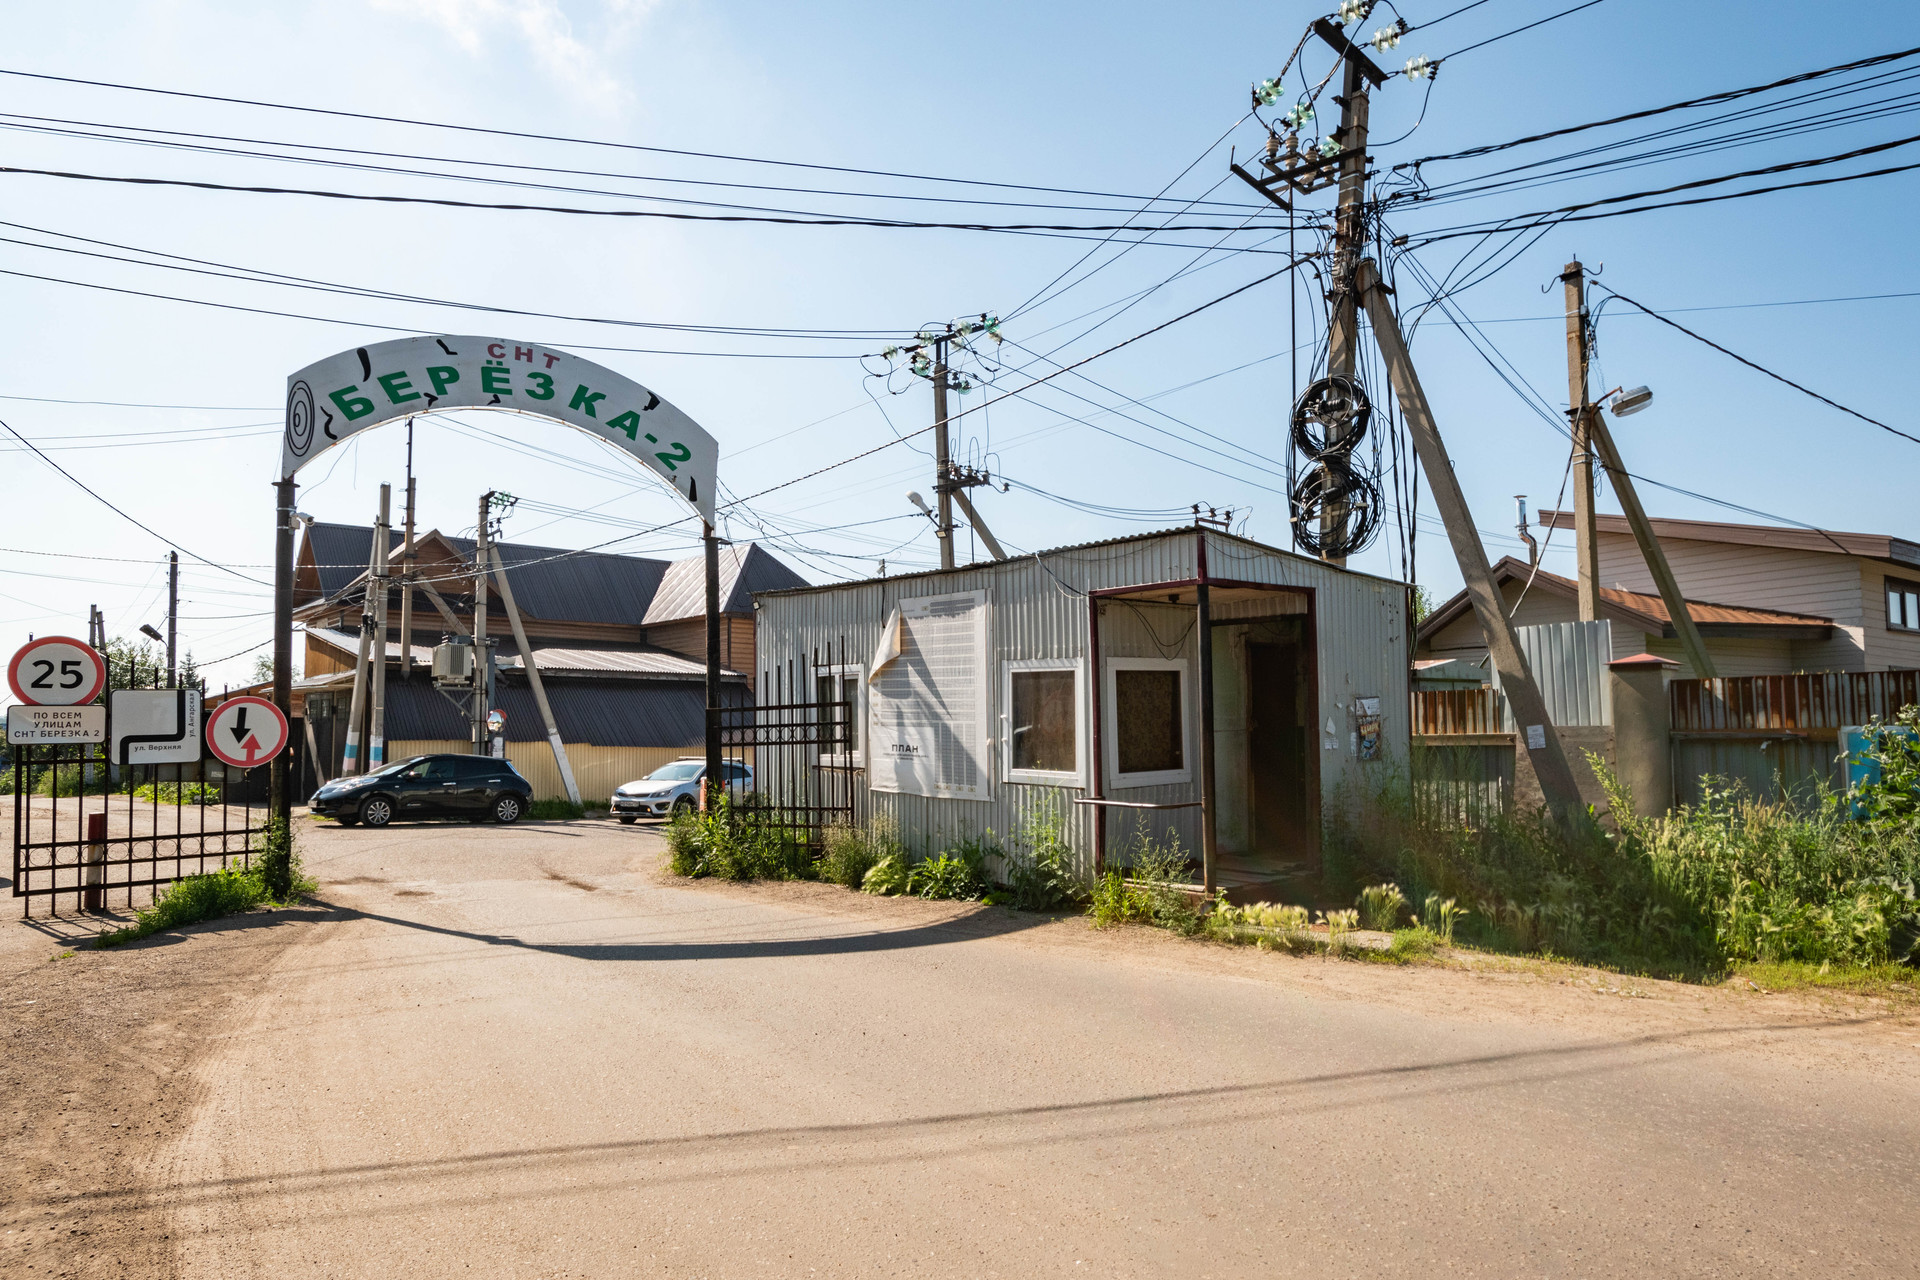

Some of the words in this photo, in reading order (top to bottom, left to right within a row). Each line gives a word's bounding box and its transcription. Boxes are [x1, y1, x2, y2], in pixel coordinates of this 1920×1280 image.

[487, 343, 561, 370] СНТ
[328, 359, 692, 471] БЕРЁЗКА-2
[30, 660, 84, 689] 25
[188, 692, 196, 727] Ангарская
[33, 712, 48, 720] ПО
[52, 711, 82, 720] ВСЕМ
[33, 721, 82, 729] УЛИЦАМ
[14, 730, 36, 738] СНТ
[40, 730, 90, 738] БЕРЕЗКА
[93, 729, 100, 737] 2
[148, 744, 182, 752] Верхняя
[891, 744, 919, 753] ПЛАН
